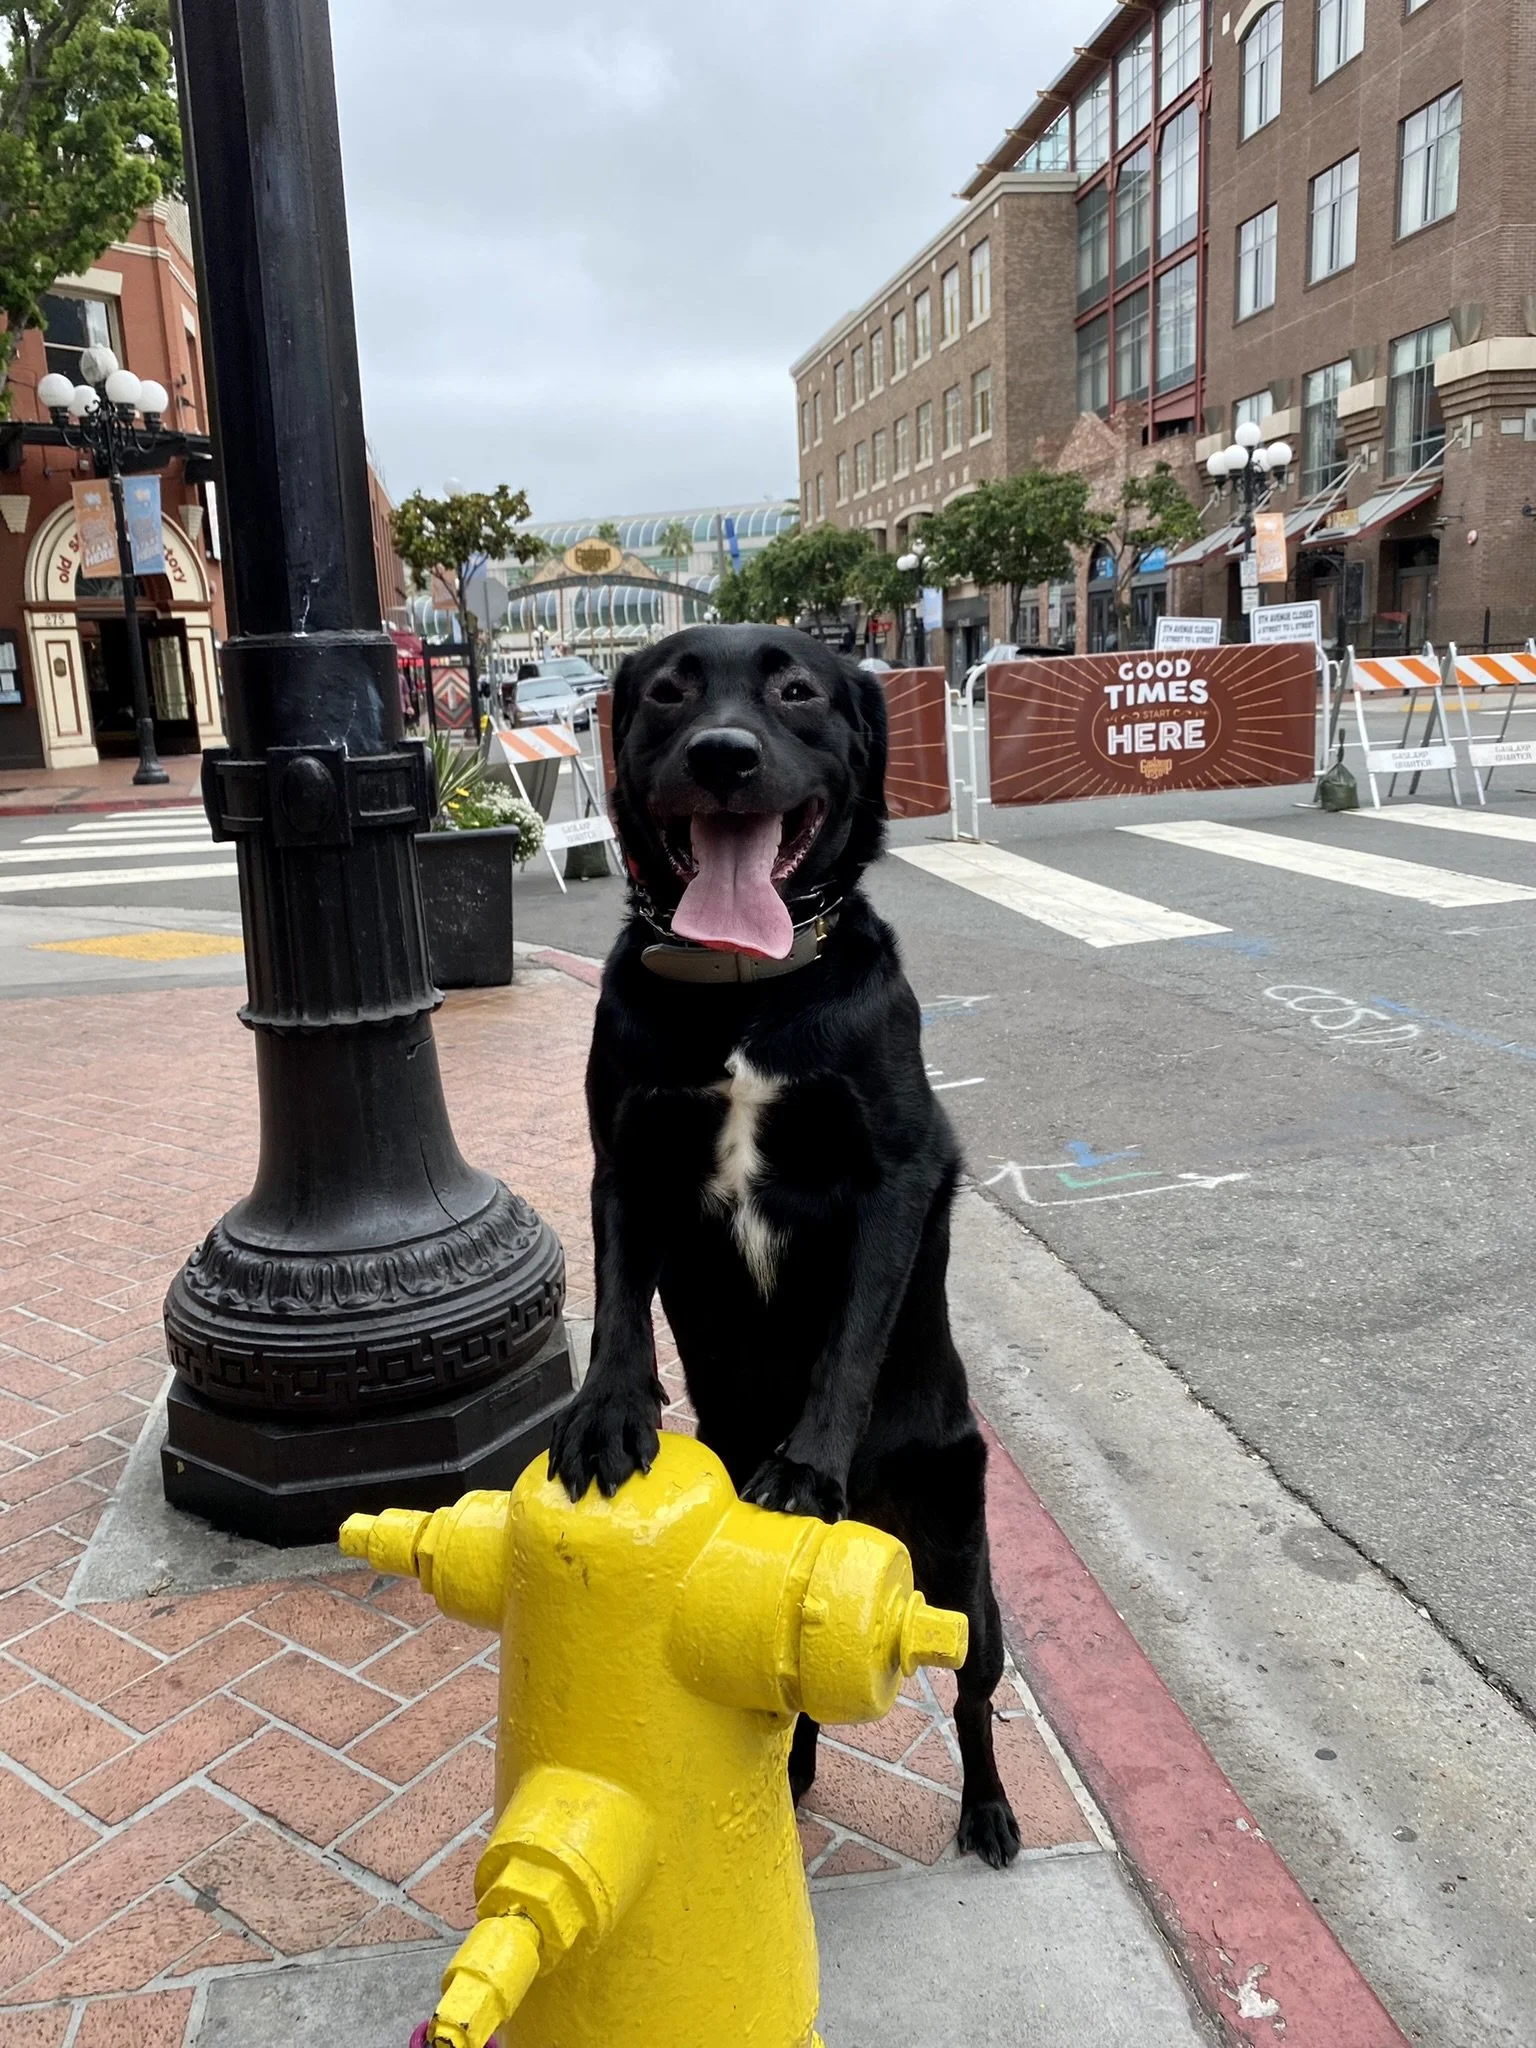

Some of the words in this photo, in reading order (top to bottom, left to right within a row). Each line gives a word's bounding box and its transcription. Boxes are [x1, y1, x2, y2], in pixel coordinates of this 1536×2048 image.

[1270, 612, 1291, 622] AVENUE
[1292, 609, 1314, 620] CLOSED
[1174, 625, 1193, 634] AVENUE
[1194, 625, 1214, 634] CLOSED
[1118, 658, 1191, 681] GOOD
[1103, 678, 1209, 710] TIMES
[1142, 709, 1171, 720] START
[1107, 719, 1206, 755] HERE
